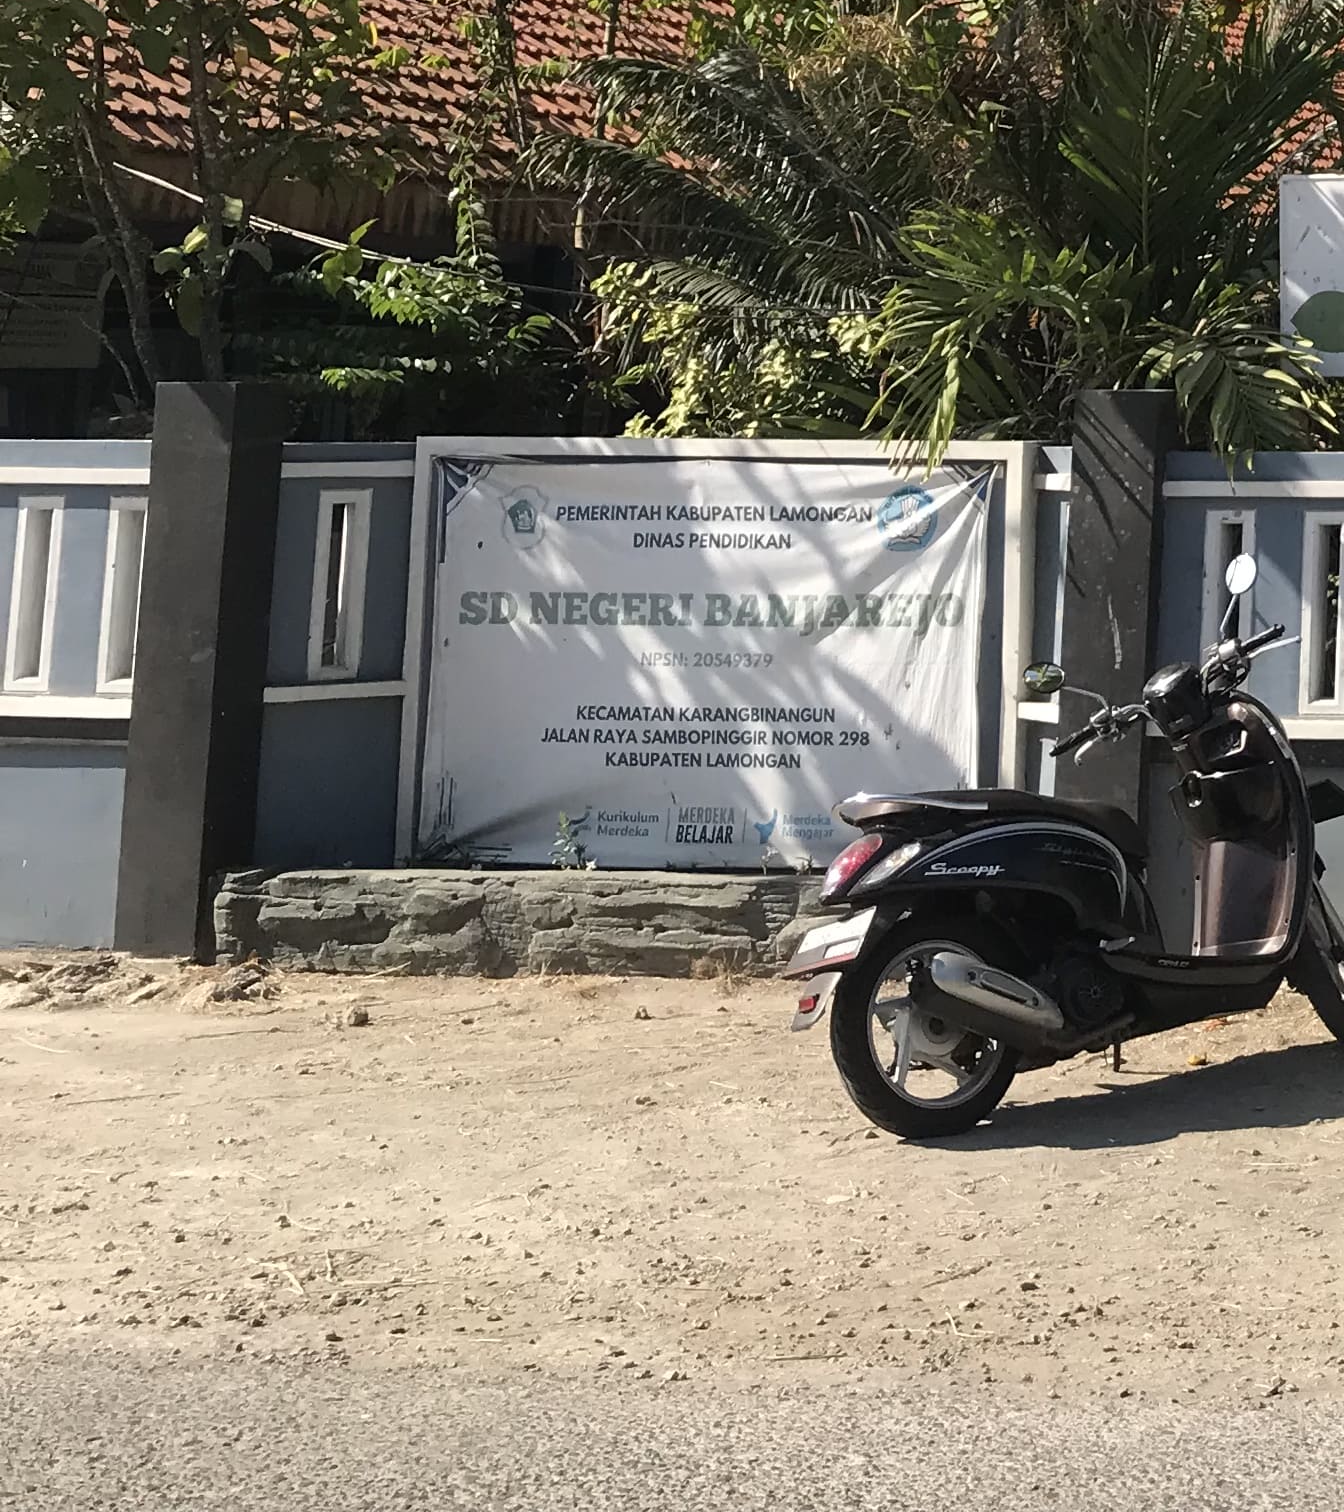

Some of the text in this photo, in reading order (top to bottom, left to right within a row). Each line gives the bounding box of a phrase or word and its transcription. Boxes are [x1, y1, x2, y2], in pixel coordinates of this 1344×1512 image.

[555, 504, 873, 523] PEMERINTAH KABUPATEN LAMONGAN
[632, 531, 791, 549] DINAS PENDIDIKAN
[459, 591, 965, 637] SD NEGERI BANJAREJO
[640, 651, 774, 669] NPSN: 20549379
[576, 705, 836, 724] KECAMATAN KARANGBINANGUN
[541, 728, 870, 747] JALAN RAYA SAMBOPINGGIR NOMOR 298
[605, 751, 802, 770] KABUPATEN LAMONGAN
[597, 810, 660, 824] Kurikulum
[678, 806, 735, 825] MERDEKA
[783, 813, 831, 826] Merdeka
[597, 824, 649, 837] Merdeka
[675, 825, 734, 844] BELAJAR
[782, 826, 834, 839] Mengajar
[924, 863, 1006, 876] Scoopy
